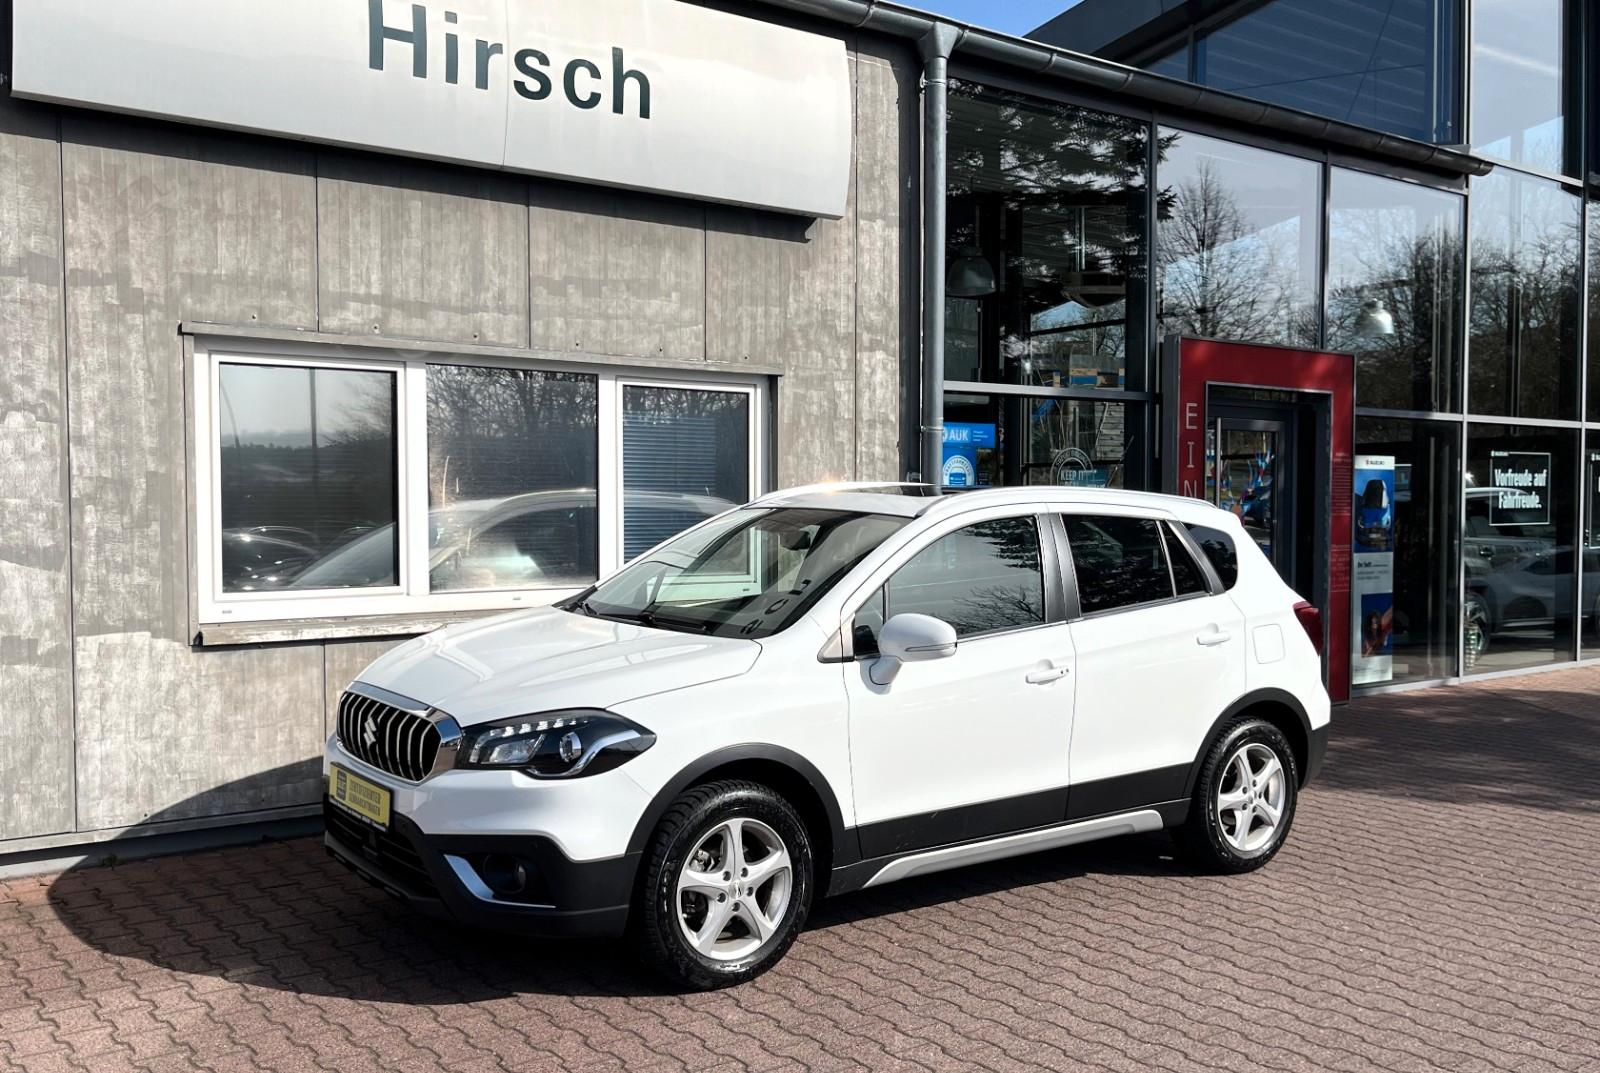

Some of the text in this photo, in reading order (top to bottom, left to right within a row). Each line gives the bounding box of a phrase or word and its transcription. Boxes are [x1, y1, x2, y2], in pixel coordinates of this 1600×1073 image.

[369, 0, 650, 119] Hirsch
[1494, 469, 1547, 487] Vorfreude auf
